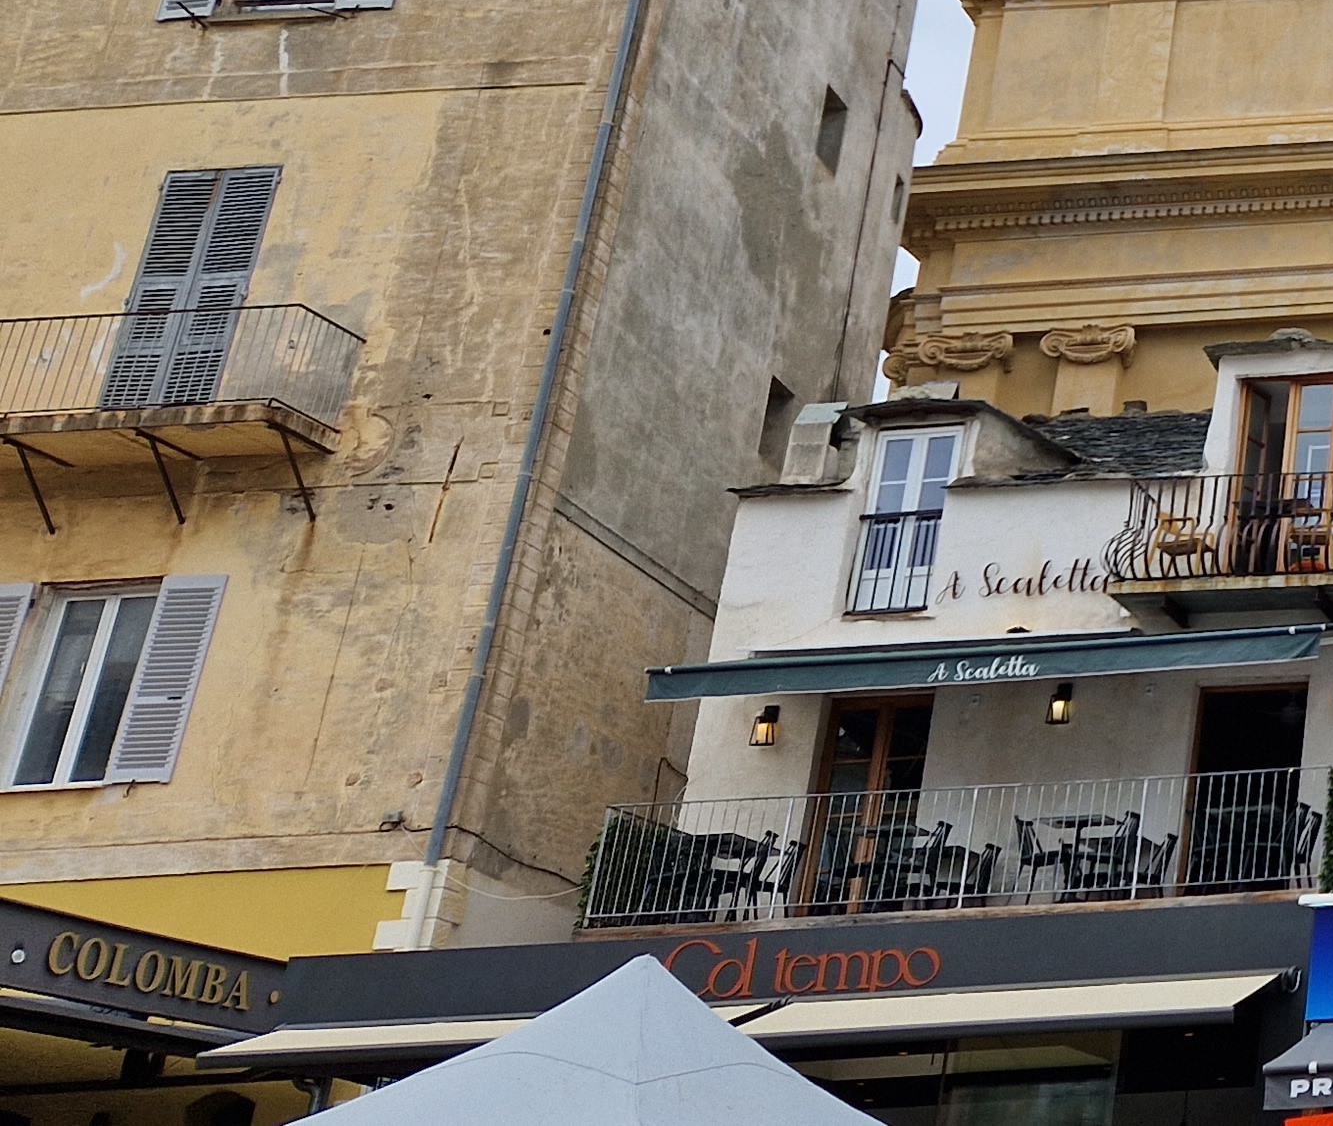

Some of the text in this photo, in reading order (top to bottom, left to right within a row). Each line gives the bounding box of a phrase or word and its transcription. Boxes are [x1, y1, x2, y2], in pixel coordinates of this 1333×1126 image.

[935, 558, 1110, 604] A Scaletta
[927, 655, 1041, 682] A Scaletta
[48, 931, 250, 1011] COLOMBA
[663, 937, 942, 998] Col tempo
